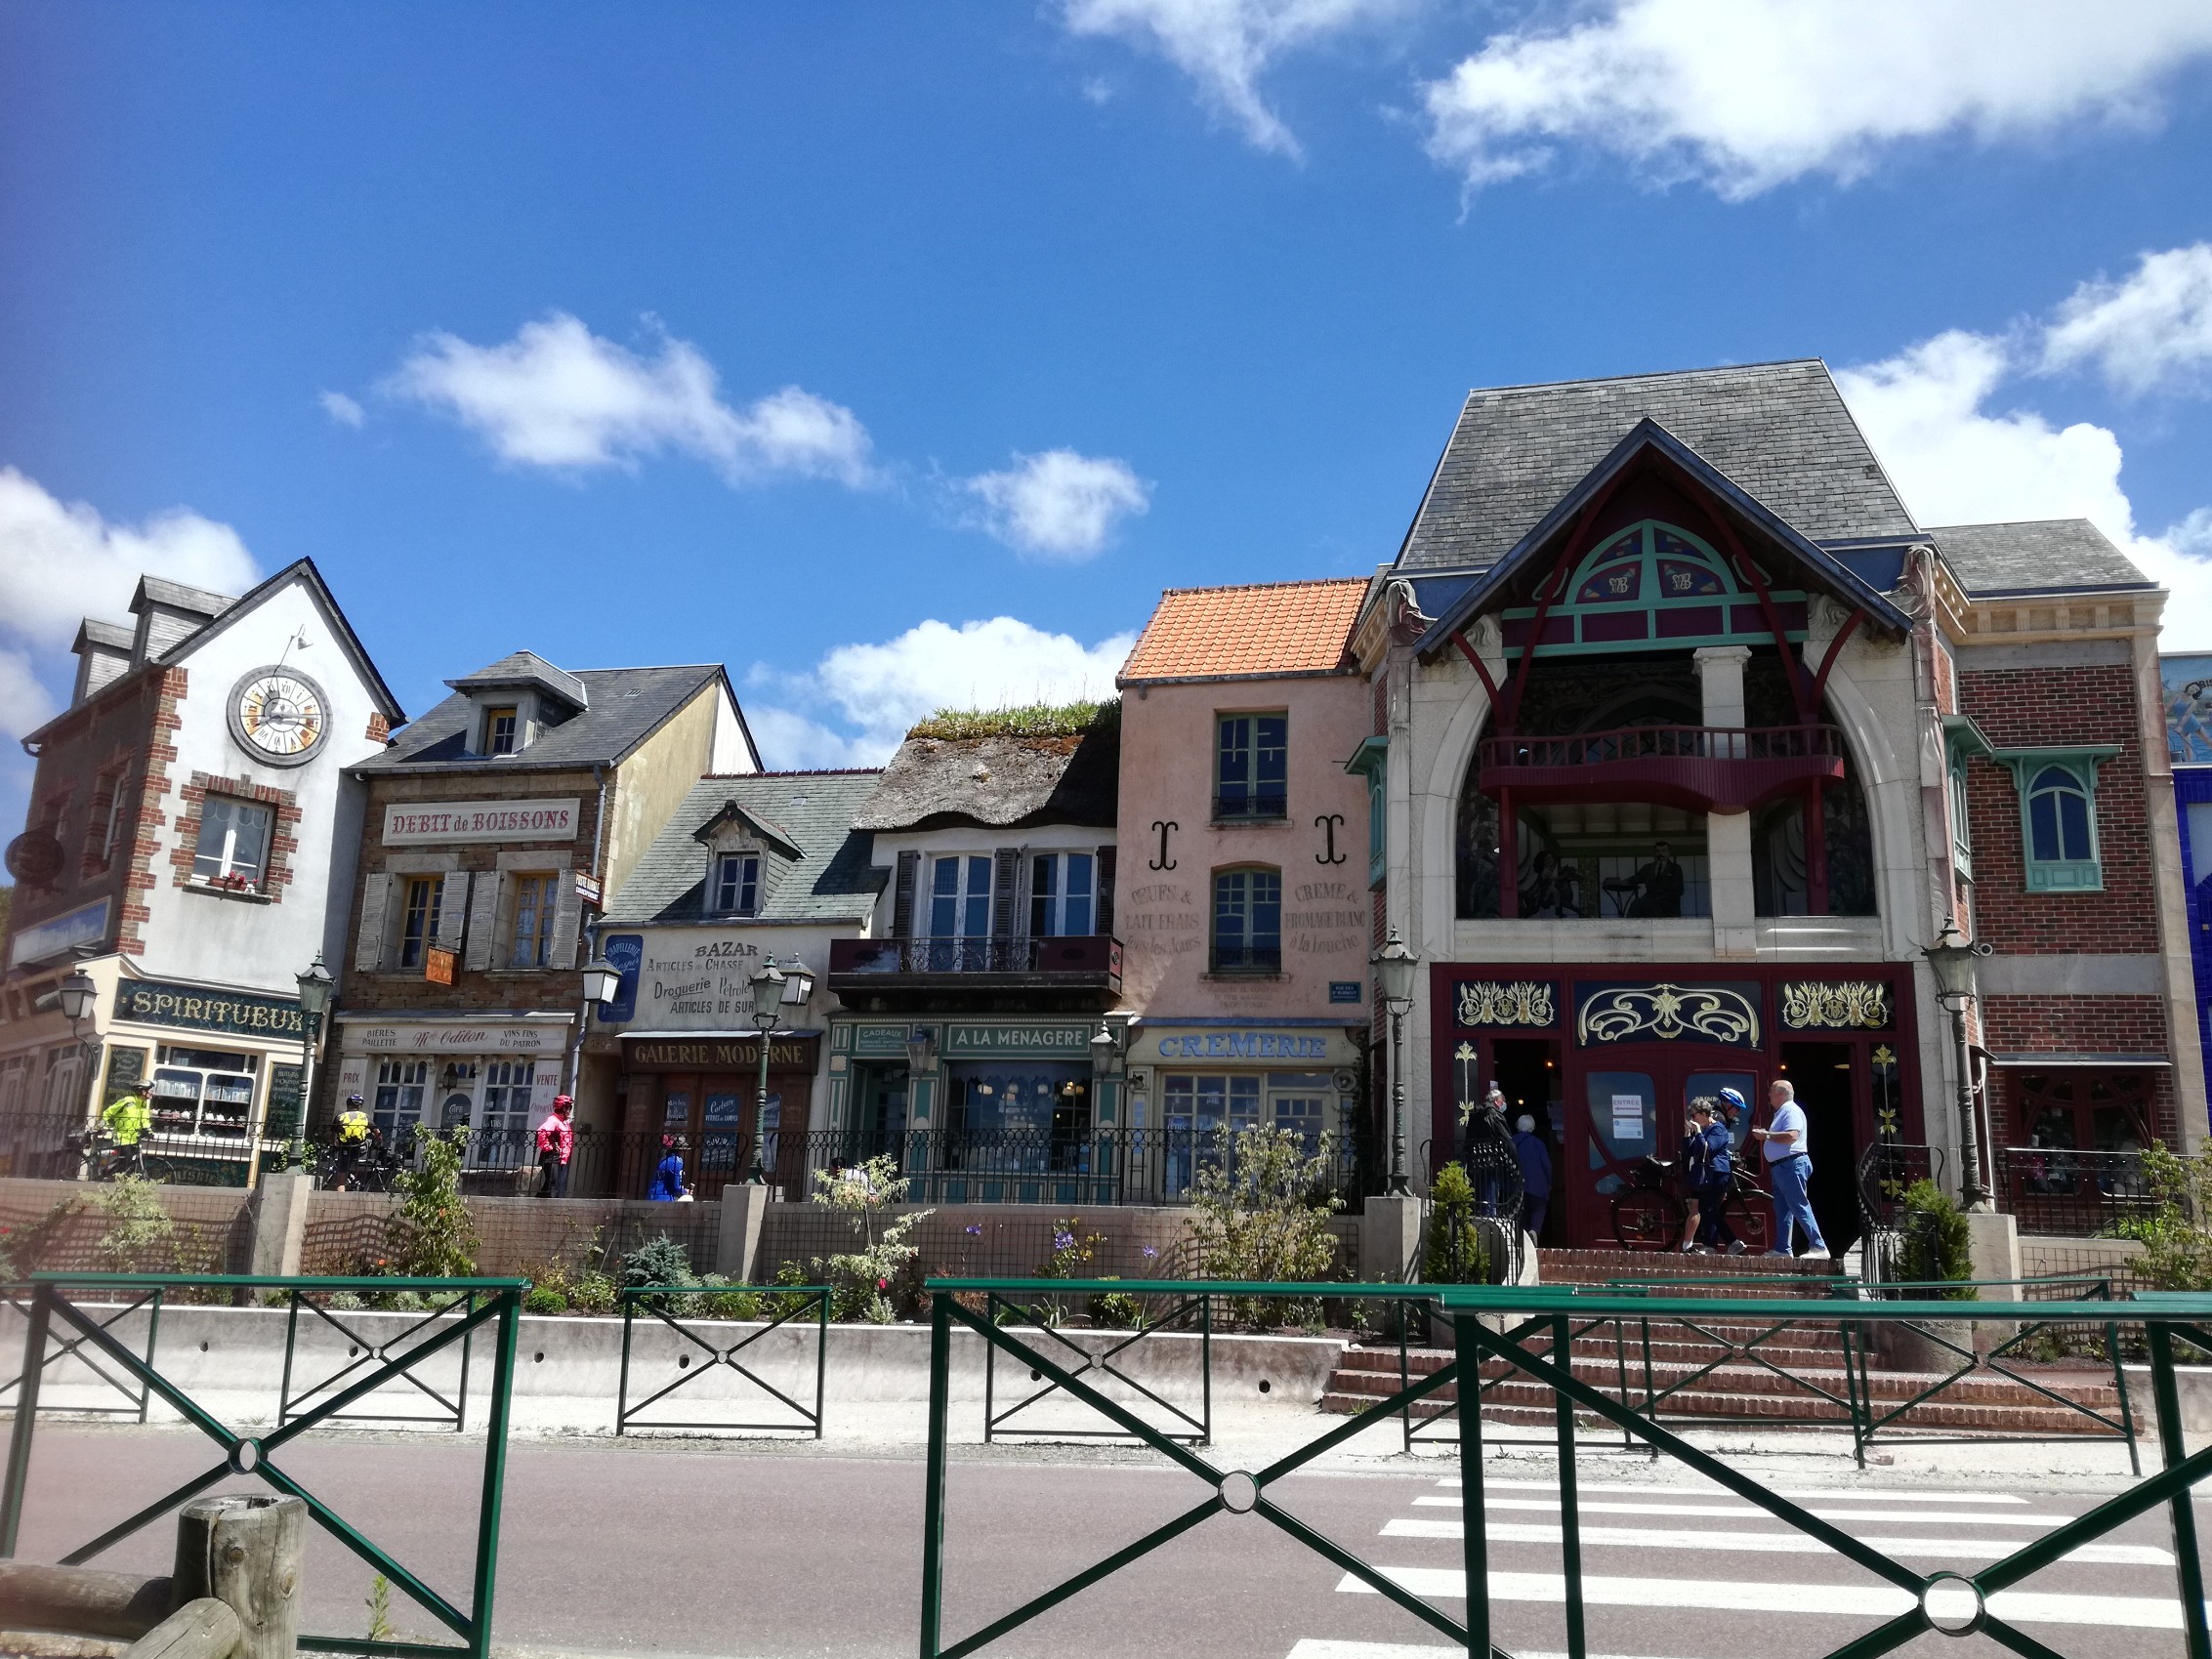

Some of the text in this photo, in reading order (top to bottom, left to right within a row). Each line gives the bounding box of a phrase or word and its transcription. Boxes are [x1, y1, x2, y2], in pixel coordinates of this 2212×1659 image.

[392, 810, 569, 835] DEBIT de BOISSONS
[606, 942, 641, 958] CHAPELLERIE
[695, 942, 759, 958] BAZAR
[654, 976, 711, 1000] Droguerie
[133, 991, 303, 1032] SPIRITUEUX
[670, 1001, 712, 1015] ARTICLES
[719, 1001, 730, 1014] DE
[361, 1038, 397, 1047] PAILLETTE
[439, 1030, 489, 1046] Odilon
[522, 1030, 538, 1039] FINS
[973, 1029, 990, 1045] LA
[997, 1029, 1083, 1046] MENAGERE
[499, 1038, 541, 1048] DU PATRON
[1158, 1031, 1327, 1058] CREMERIE
[635, 1046, 804, 1063] GALERIE MODRNE
[344, 1072, 360, 1084] PRIX
[536, 1074, 558, 1086] VENTE
